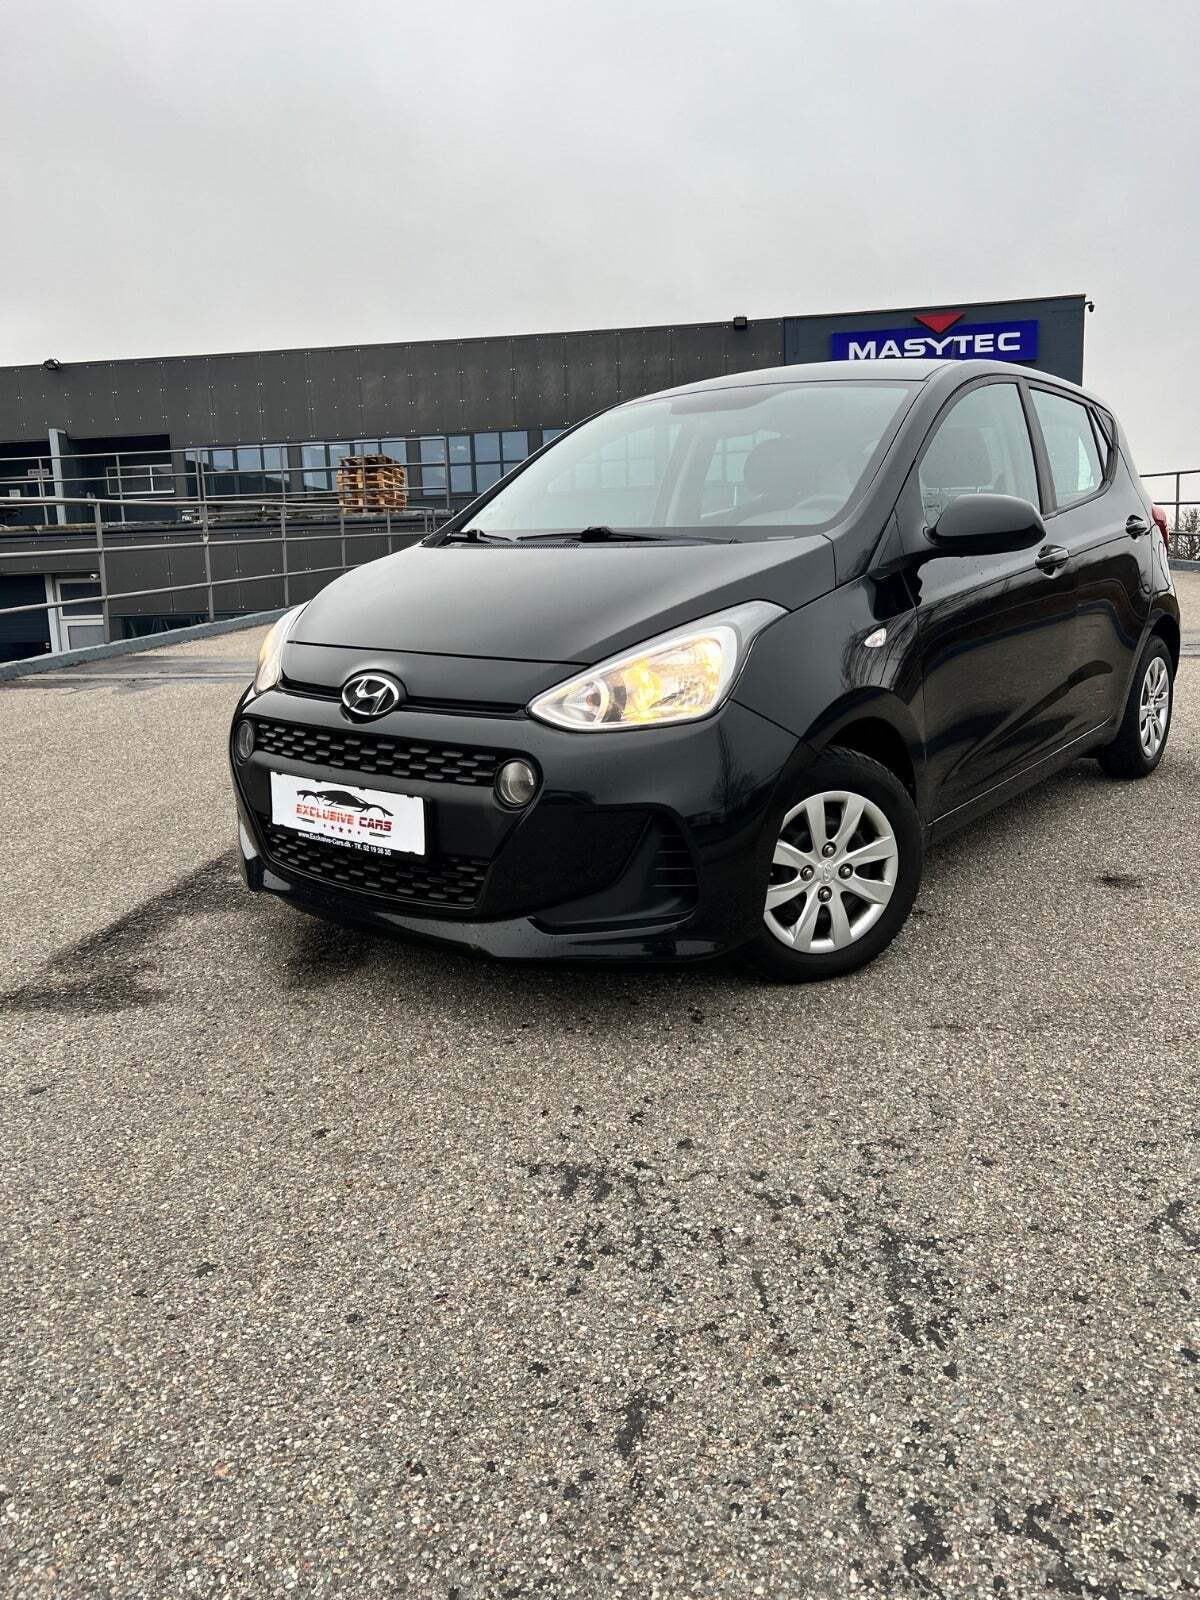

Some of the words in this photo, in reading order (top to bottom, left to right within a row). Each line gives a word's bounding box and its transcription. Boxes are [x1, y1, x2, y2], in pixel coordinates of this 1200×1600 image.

[848, 332, 1021, 360] MASYTEC
[296, 803, 354, 825] EXCLUSIVE
[359, 816, 392, 832] CARS
